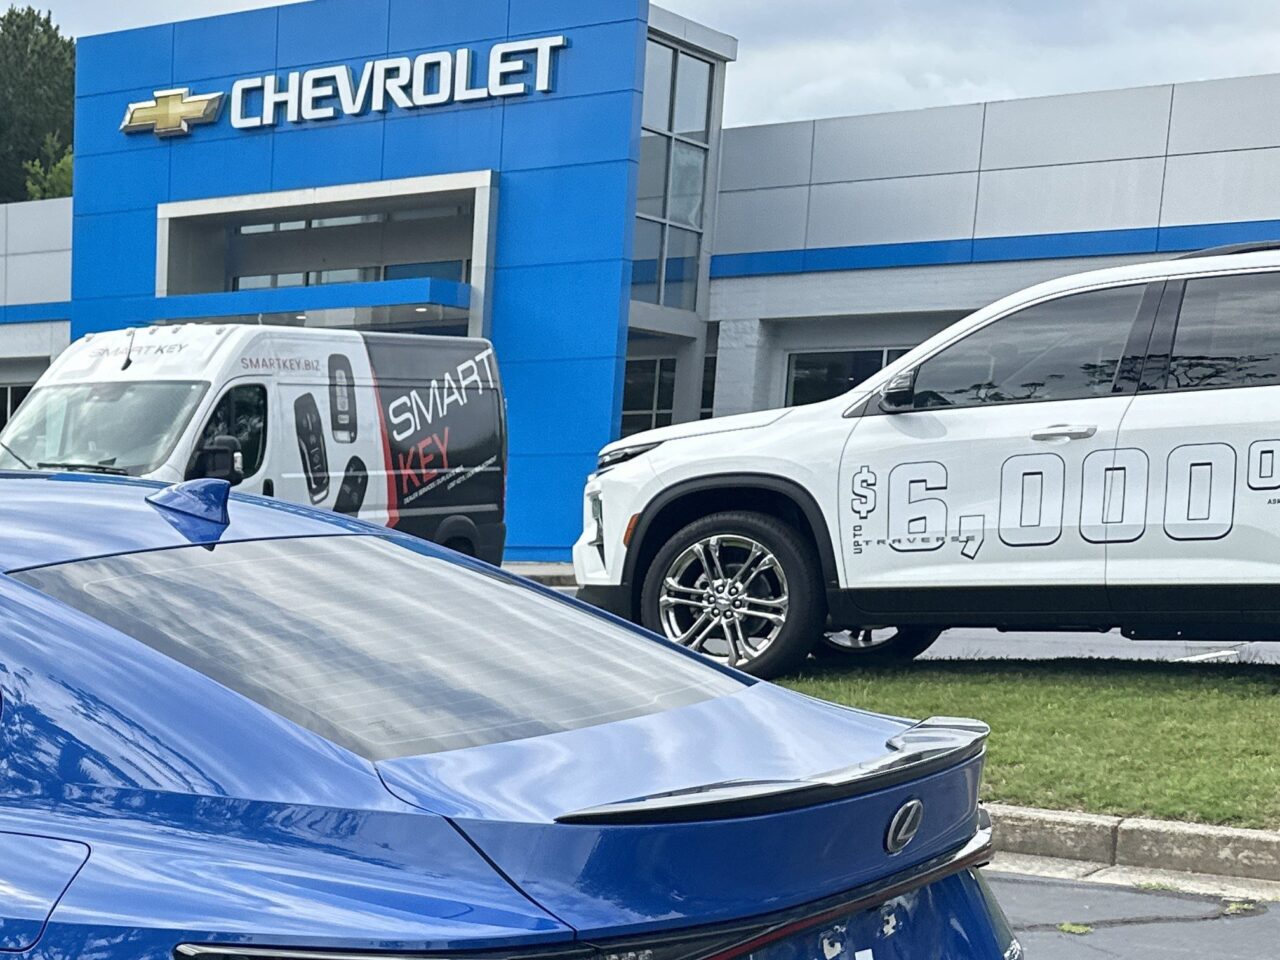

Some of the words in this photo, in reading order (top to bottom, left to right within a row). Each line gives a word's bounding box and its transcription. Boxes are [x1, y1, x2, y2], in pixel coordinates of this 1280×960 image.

[230, 34, 567, 129] CHEVROLET
[241, 357, 320, 371] SMARTKEY.BIZ
[388, 347, 494, 442] SMART
[398, 426, 449, 494] KEY
[862, 535, 975, 546] TRAVERSE
